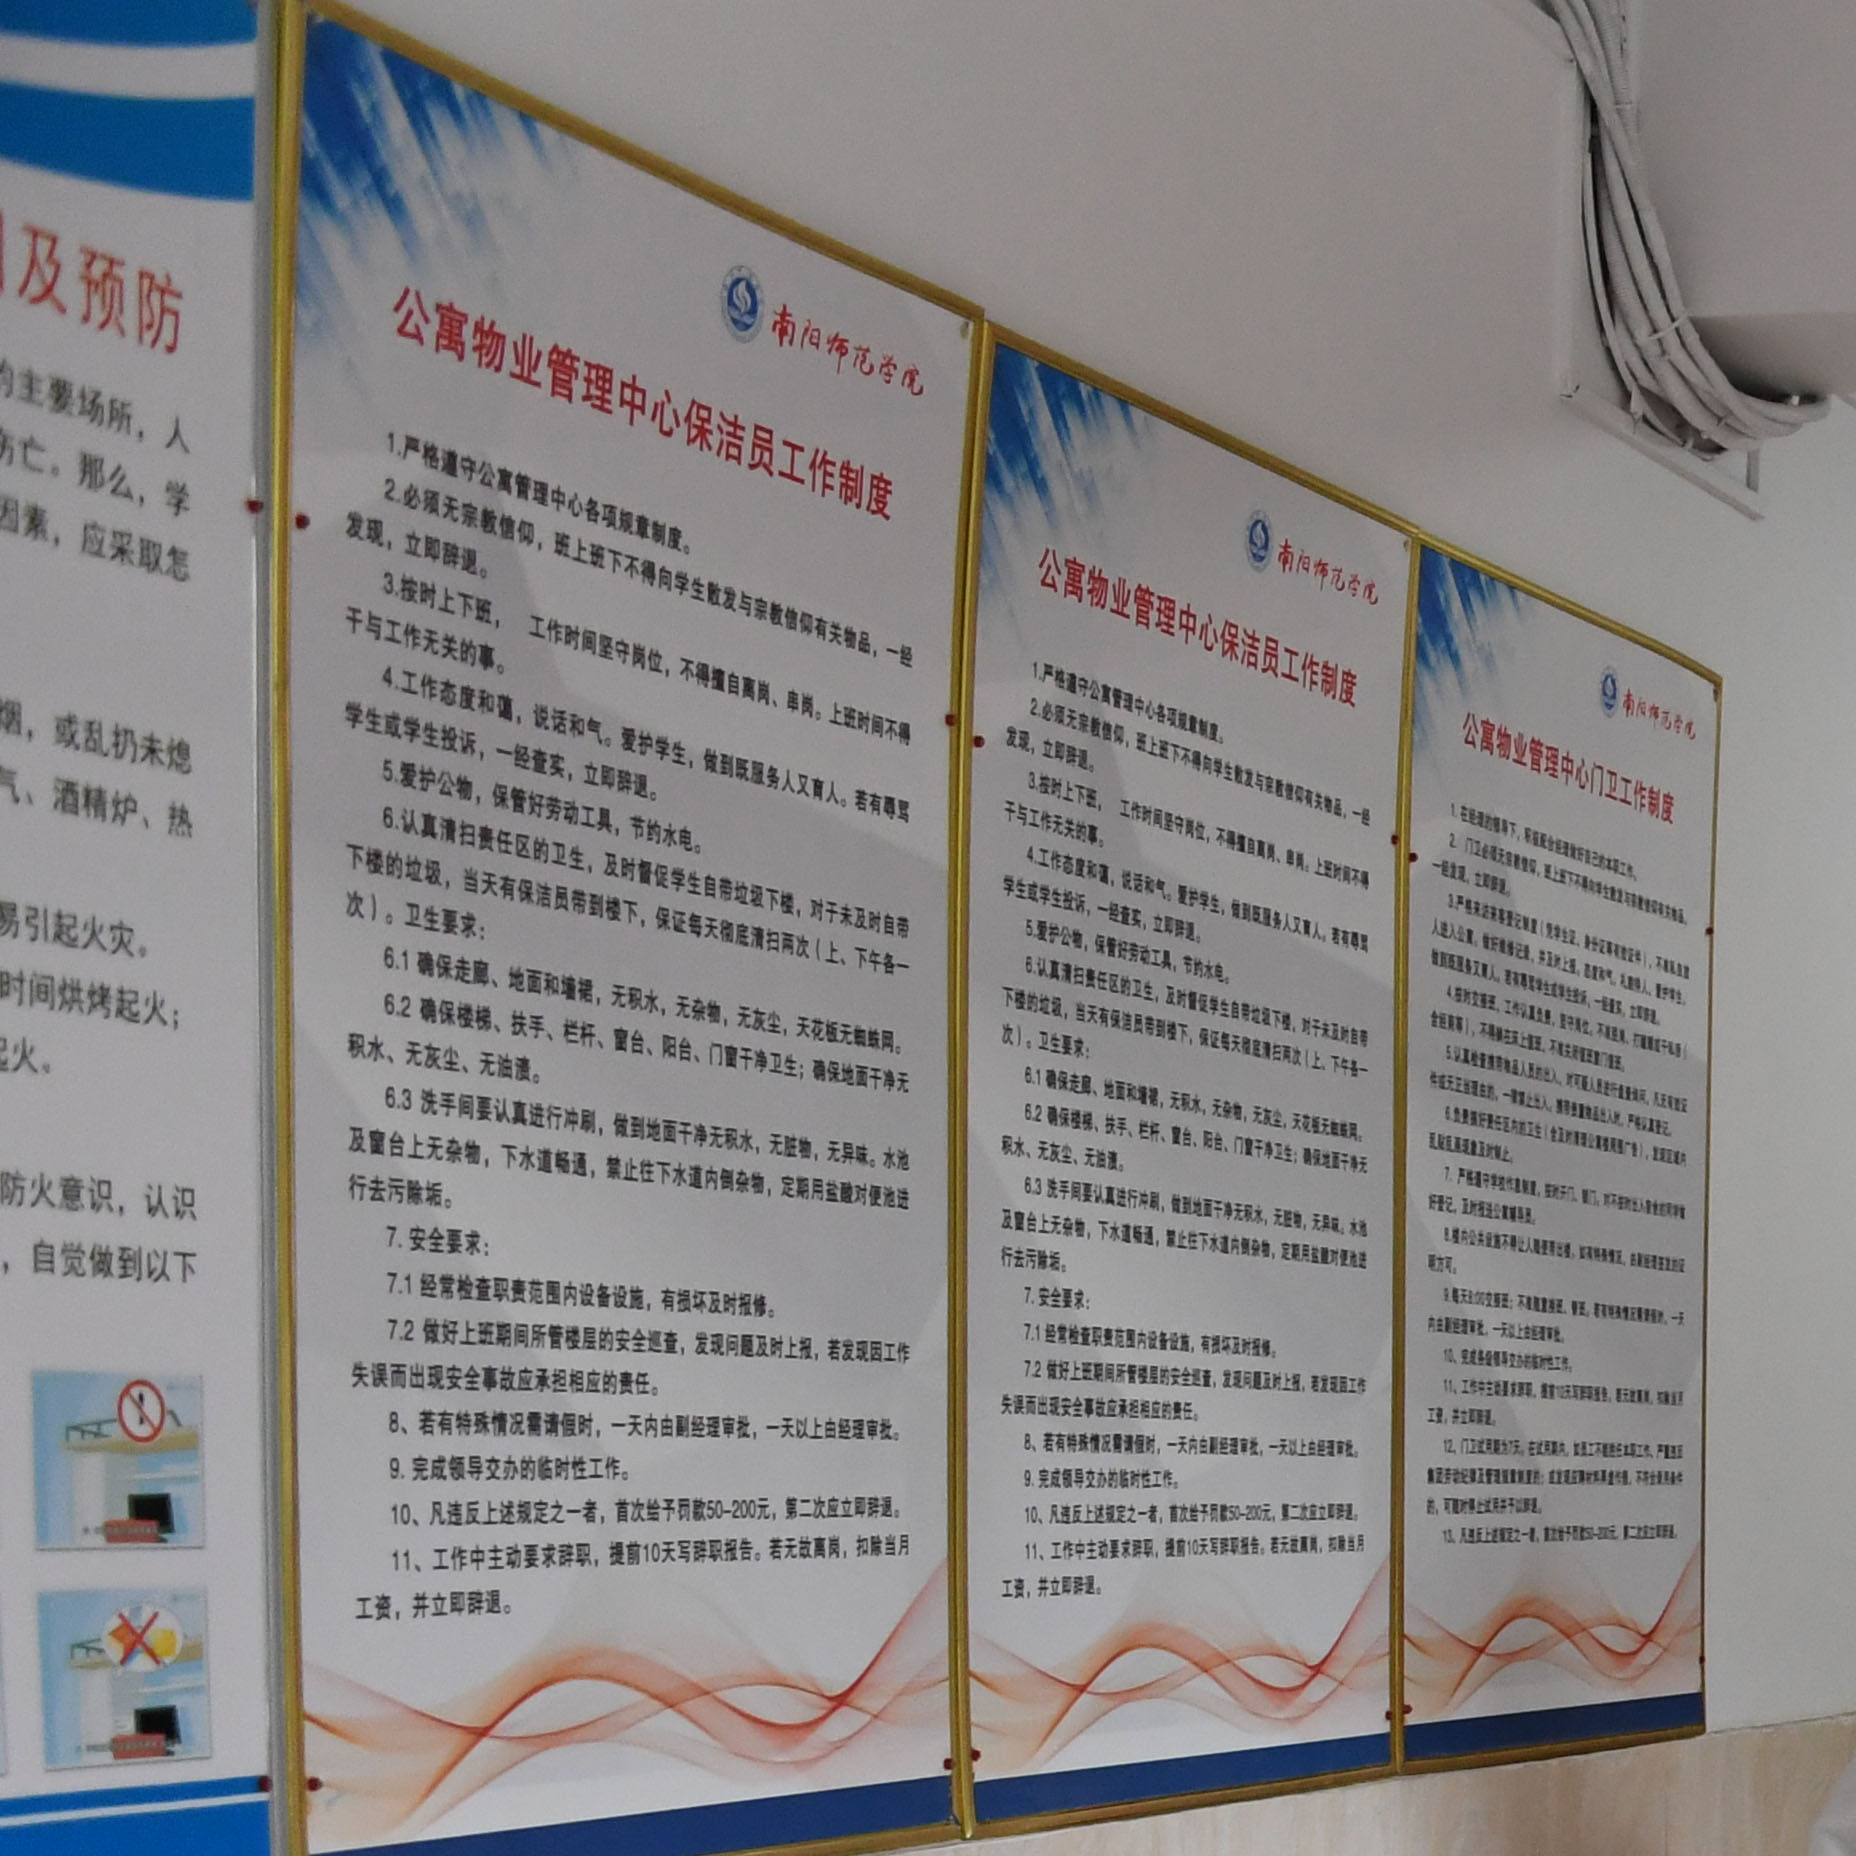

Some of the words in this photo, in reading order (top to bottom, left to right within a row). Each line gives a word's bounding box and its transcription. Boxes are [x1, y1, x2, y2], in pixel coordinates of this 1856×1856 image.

[0, 213, 183, 355] 及预防
[392, 285, 893, 522] 公寓物业管理中心保洁员工作制度
[1038, 547, 1358, 709] 公寓物业管理中心保洁员工作制度
[1462, 711, 1675, 825] 公寓物业管理中心门卫工作制度
[383, 945, 409, 971] 6.1
[383, 992, 412, 1019] 6.2
[1024, 1065, 1041, 1086] 6.1
[384, 1085, 413, 1111] 6.3
[1024, 1102, 1043, 1123] 6.2
[1024, 1175, 1043, 1196] 6.3
[385, 1225, 403, 1249] 7.
[386, 1271, 412, 1295] 7.1
[1023, 1285, 1035, 1305] 7.
[387, 1318, 415, 1342] 7.2
[1023, 1322, 1041, 1342] 7.1
[1023, 1359, 1042, 1379] 7.2
[388, 1456, 405, 1480] 9.
[1023, 1468, 1035, 1488] 9.
